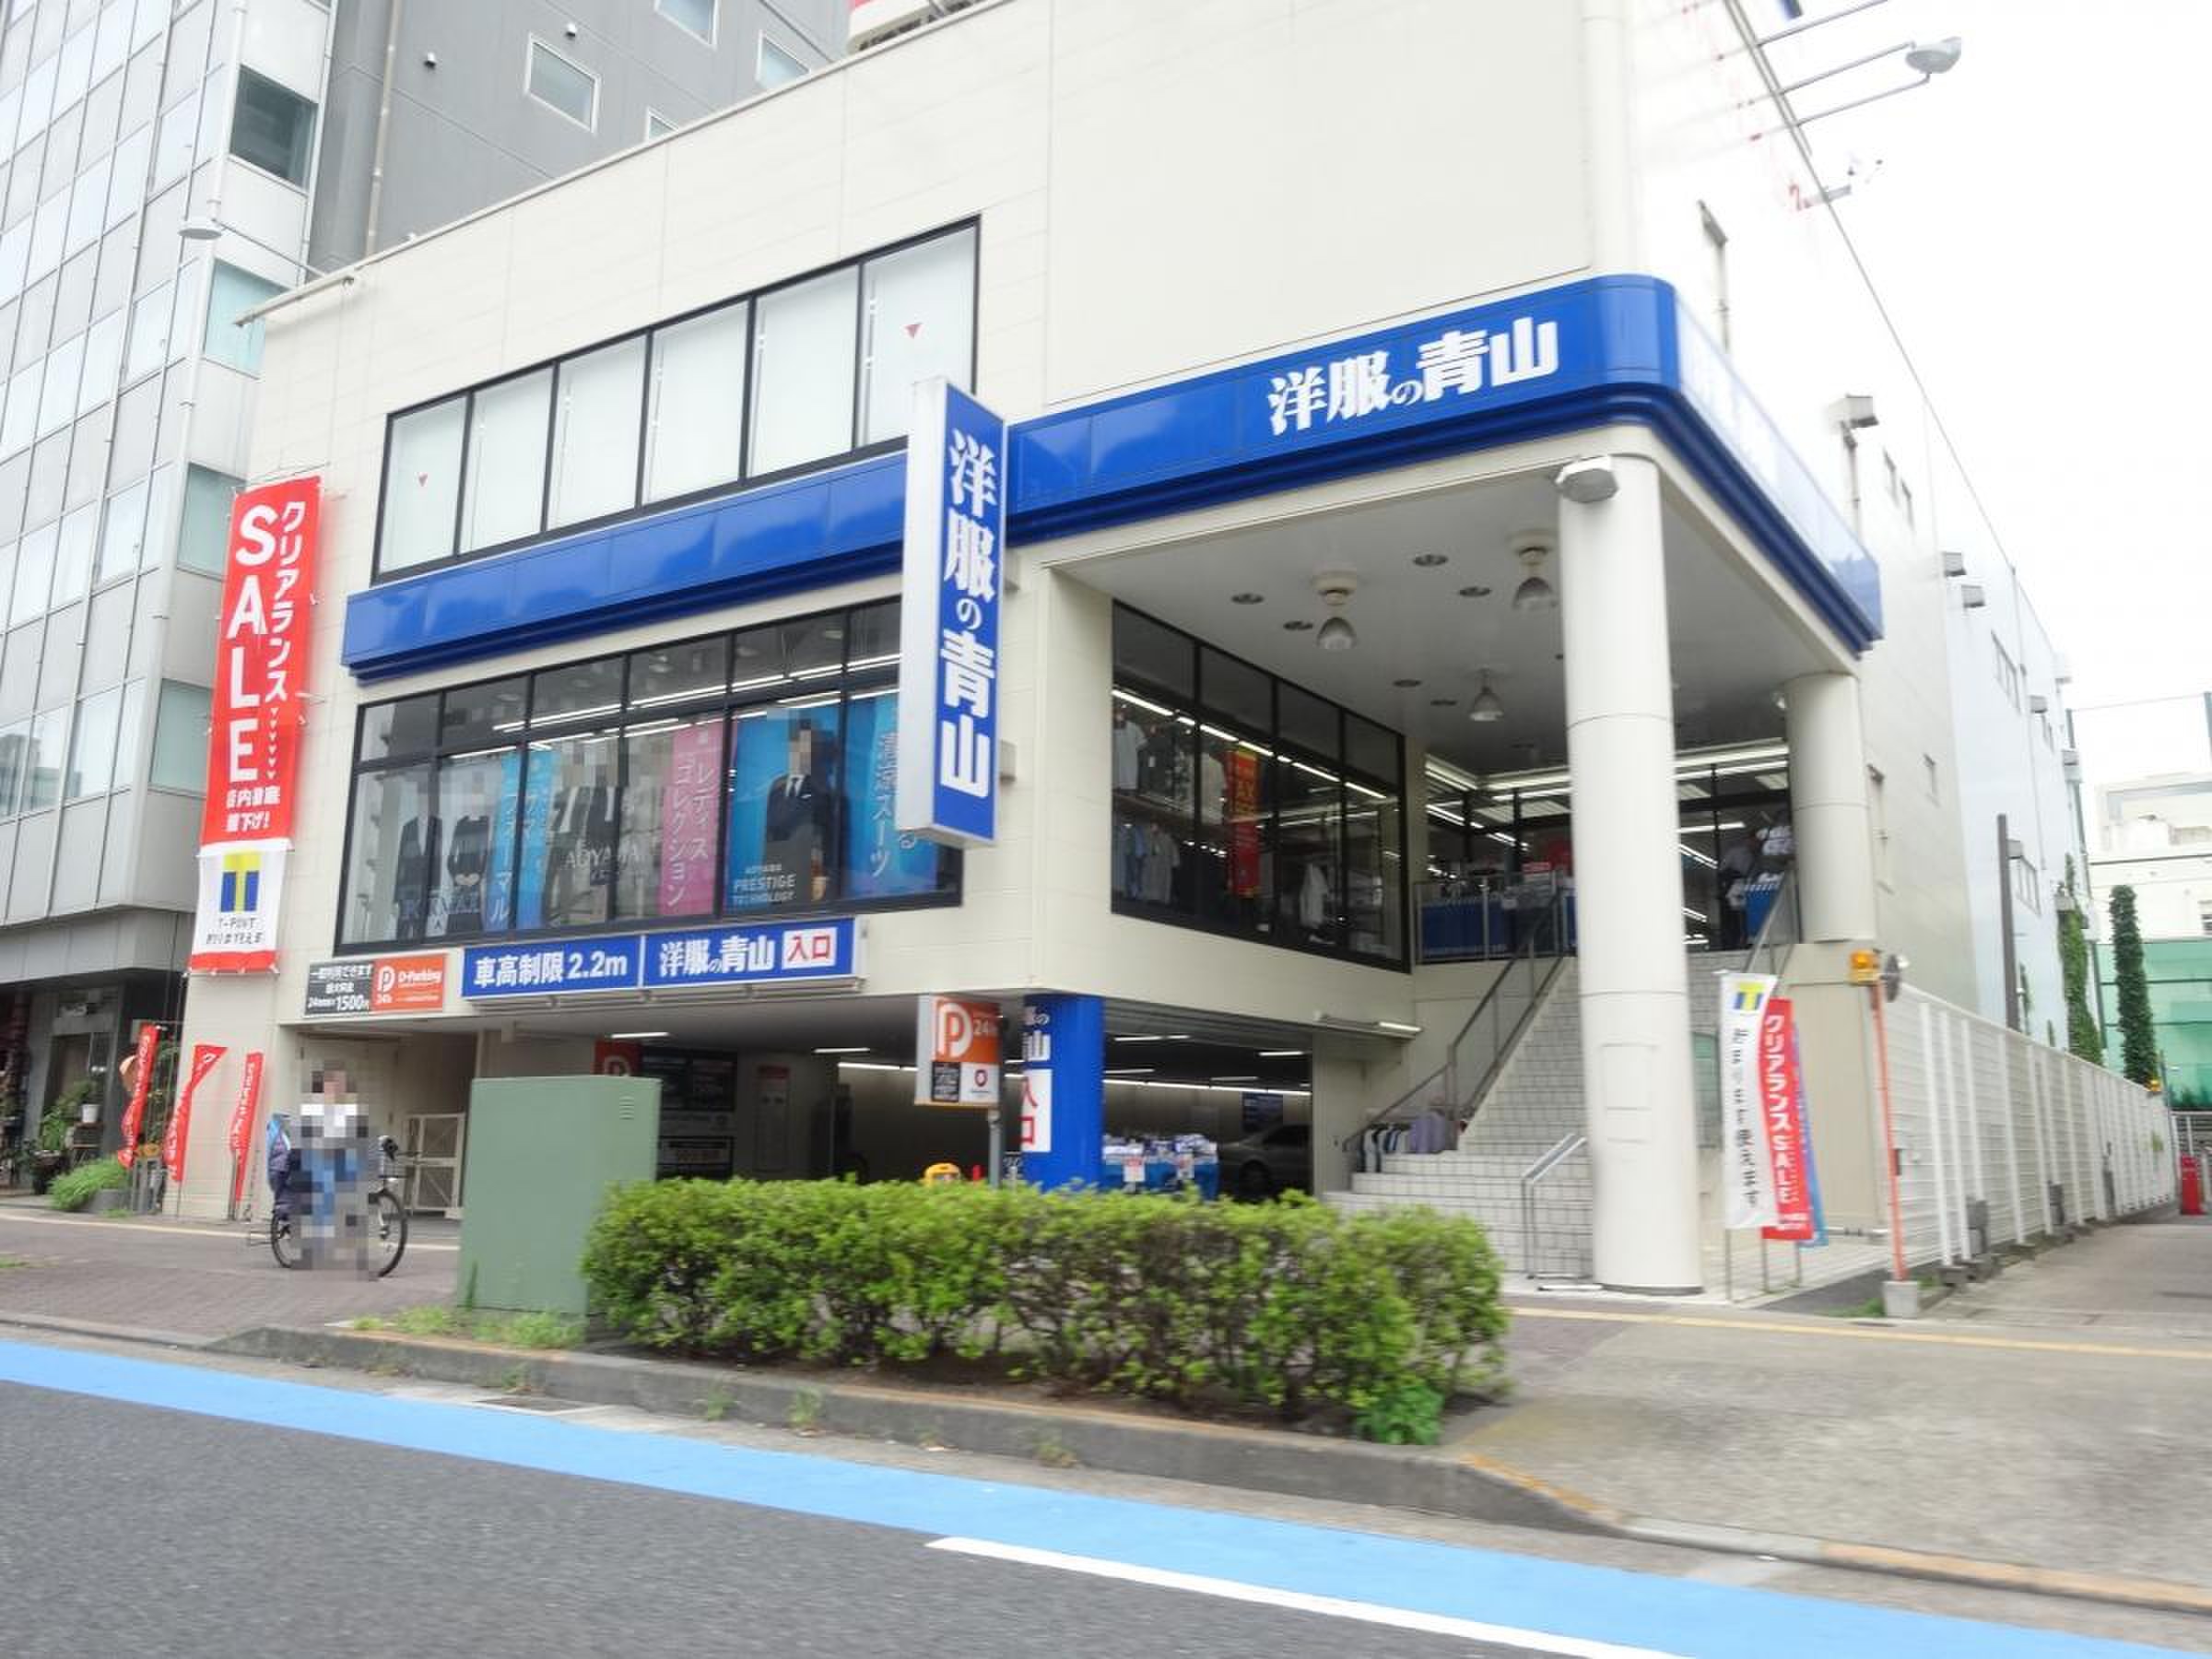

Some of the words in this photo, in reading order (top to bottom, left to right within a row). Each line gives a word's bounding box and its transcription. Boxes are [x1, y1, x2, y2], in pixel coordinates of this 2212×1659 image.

[1267, 316, 1559, 436] 洋服の青山
[227, 503, 278, 783] SALE
[265, 500, 305, 701] クリアランス
[939, 428, 998, 799] 洋服の青山
[667, 758, 696, 907] コレクション
[474, 950, 628, 988] 車高制限2.2m
[659, 935, 774, 977] 洋服の青山
[785, 933, 831, 962] 入口
